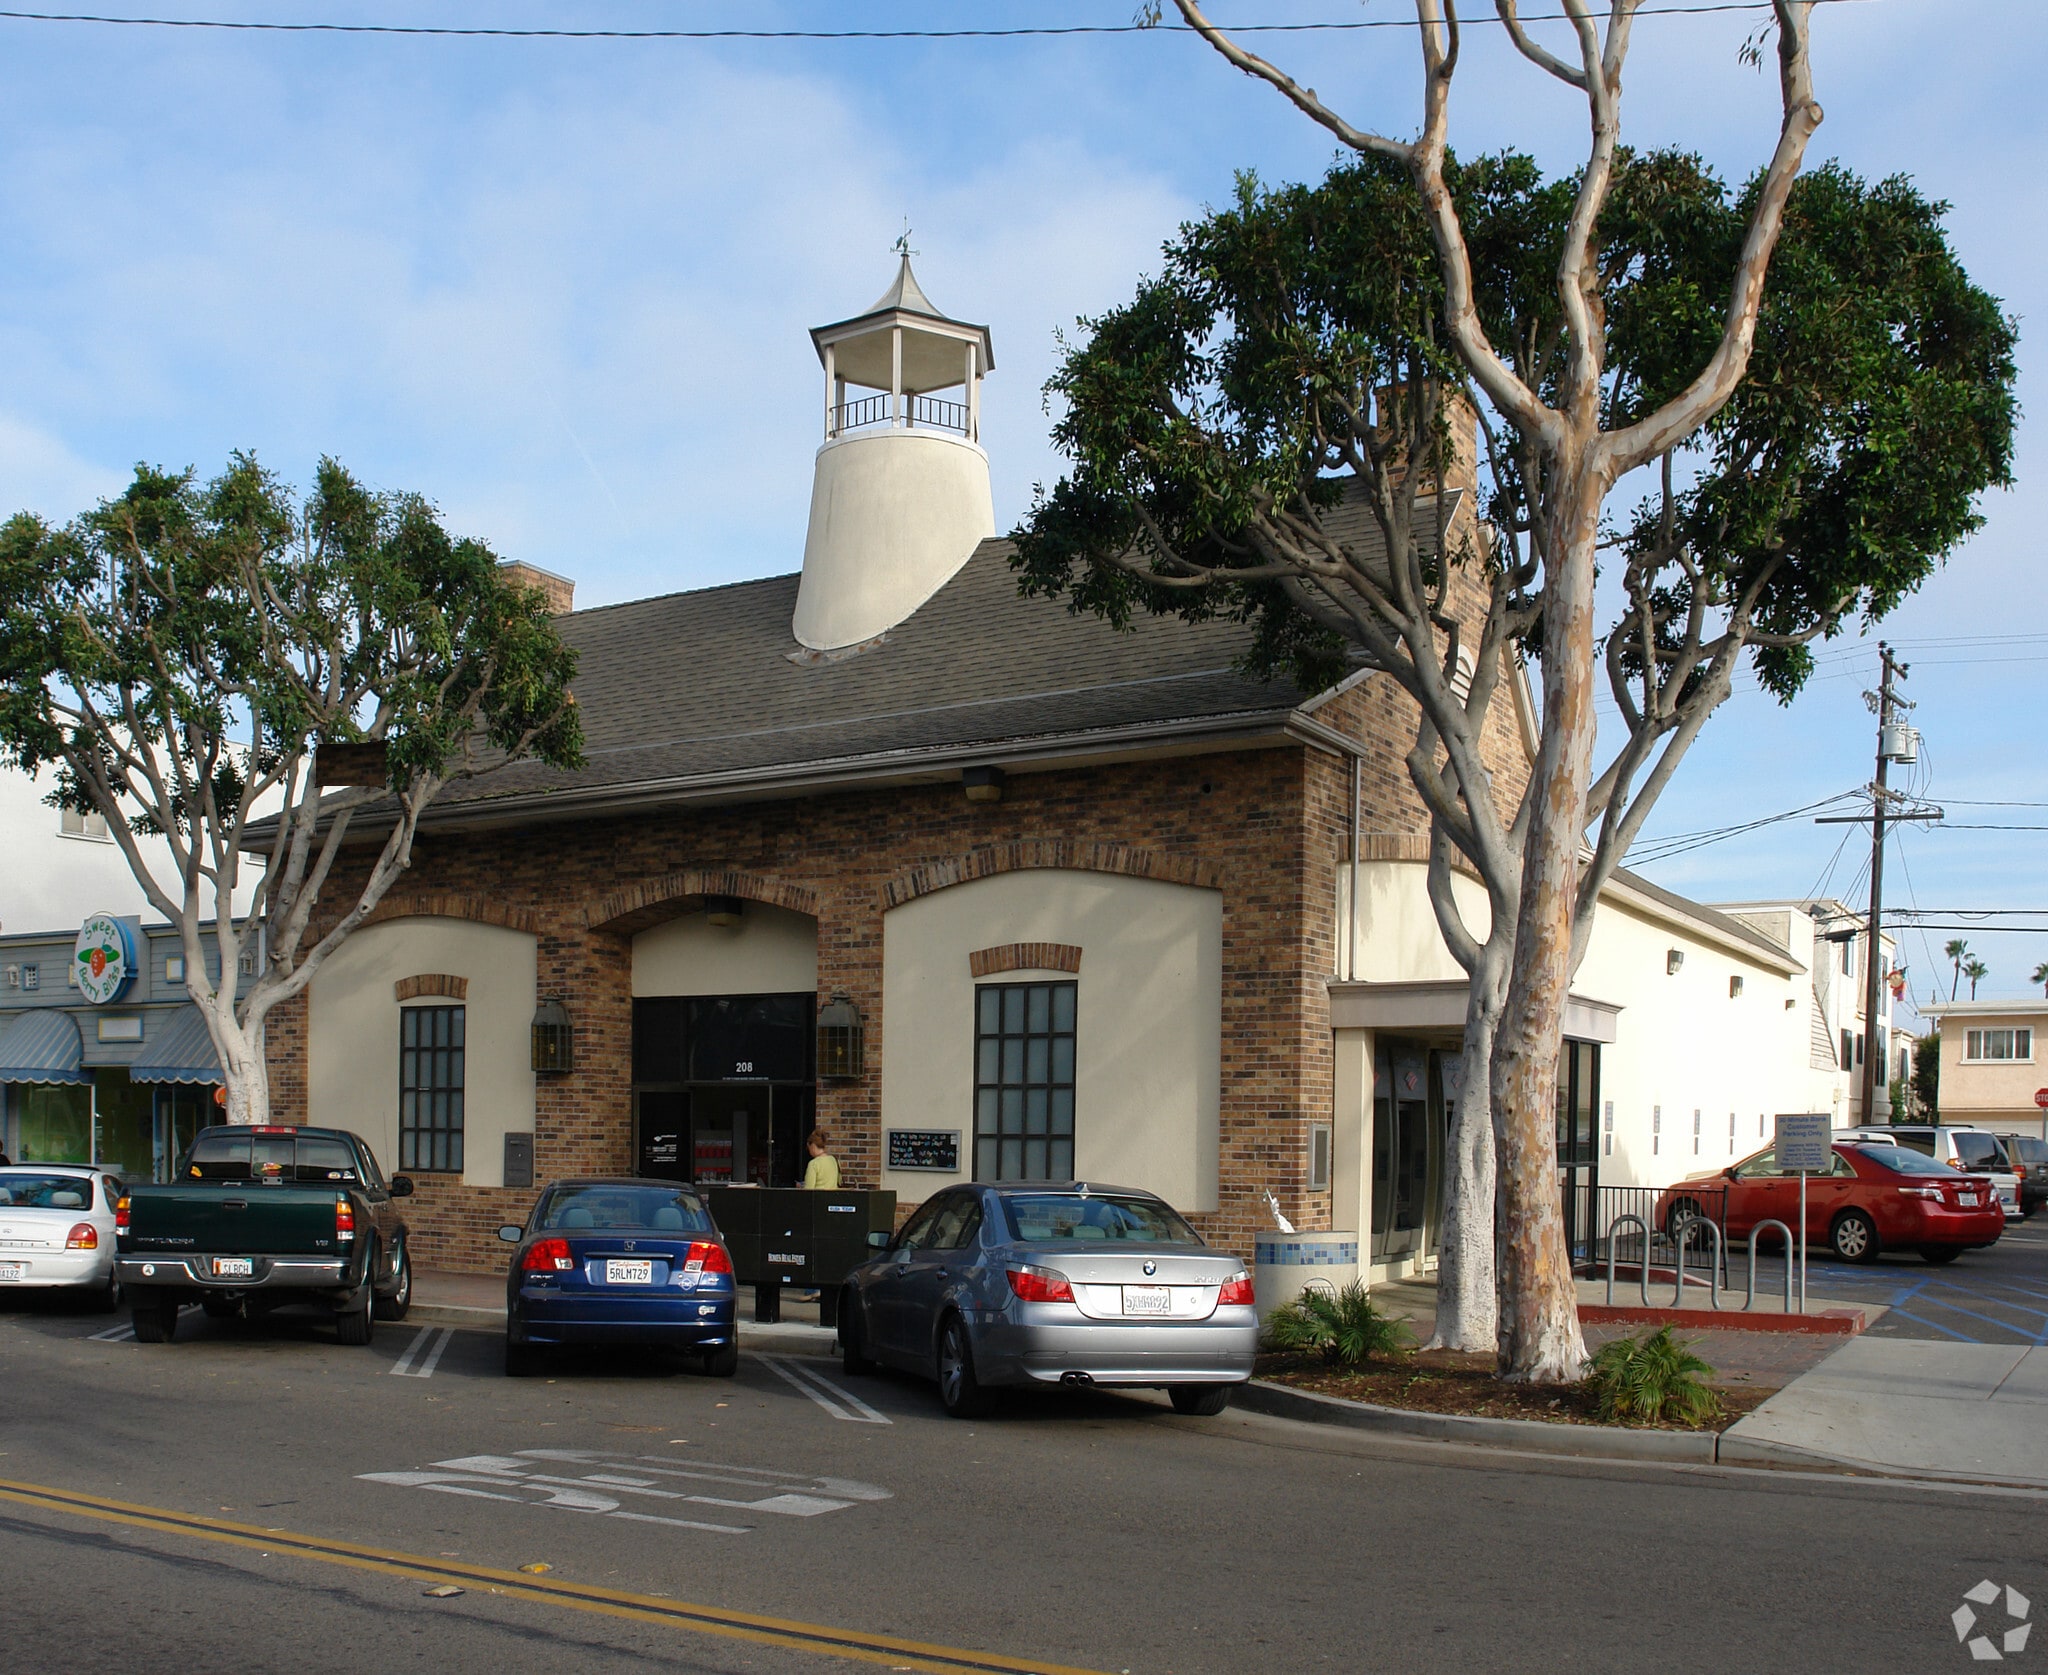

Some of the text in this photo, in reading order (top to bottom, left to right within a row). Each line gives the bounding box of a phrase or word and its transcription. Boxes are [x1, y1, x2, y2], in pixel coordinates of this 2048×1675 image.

[84, 921, 115, 940] Sweet
[79, 965, 120, 1001] Berry Bliss
[735, 1062, 753, 1073] 208
[1782, 1130, 1807, 1138] Parking
[0, 1269, 19, 1279] 4192
[609, 1267, 649, 1281] 5RLM729
